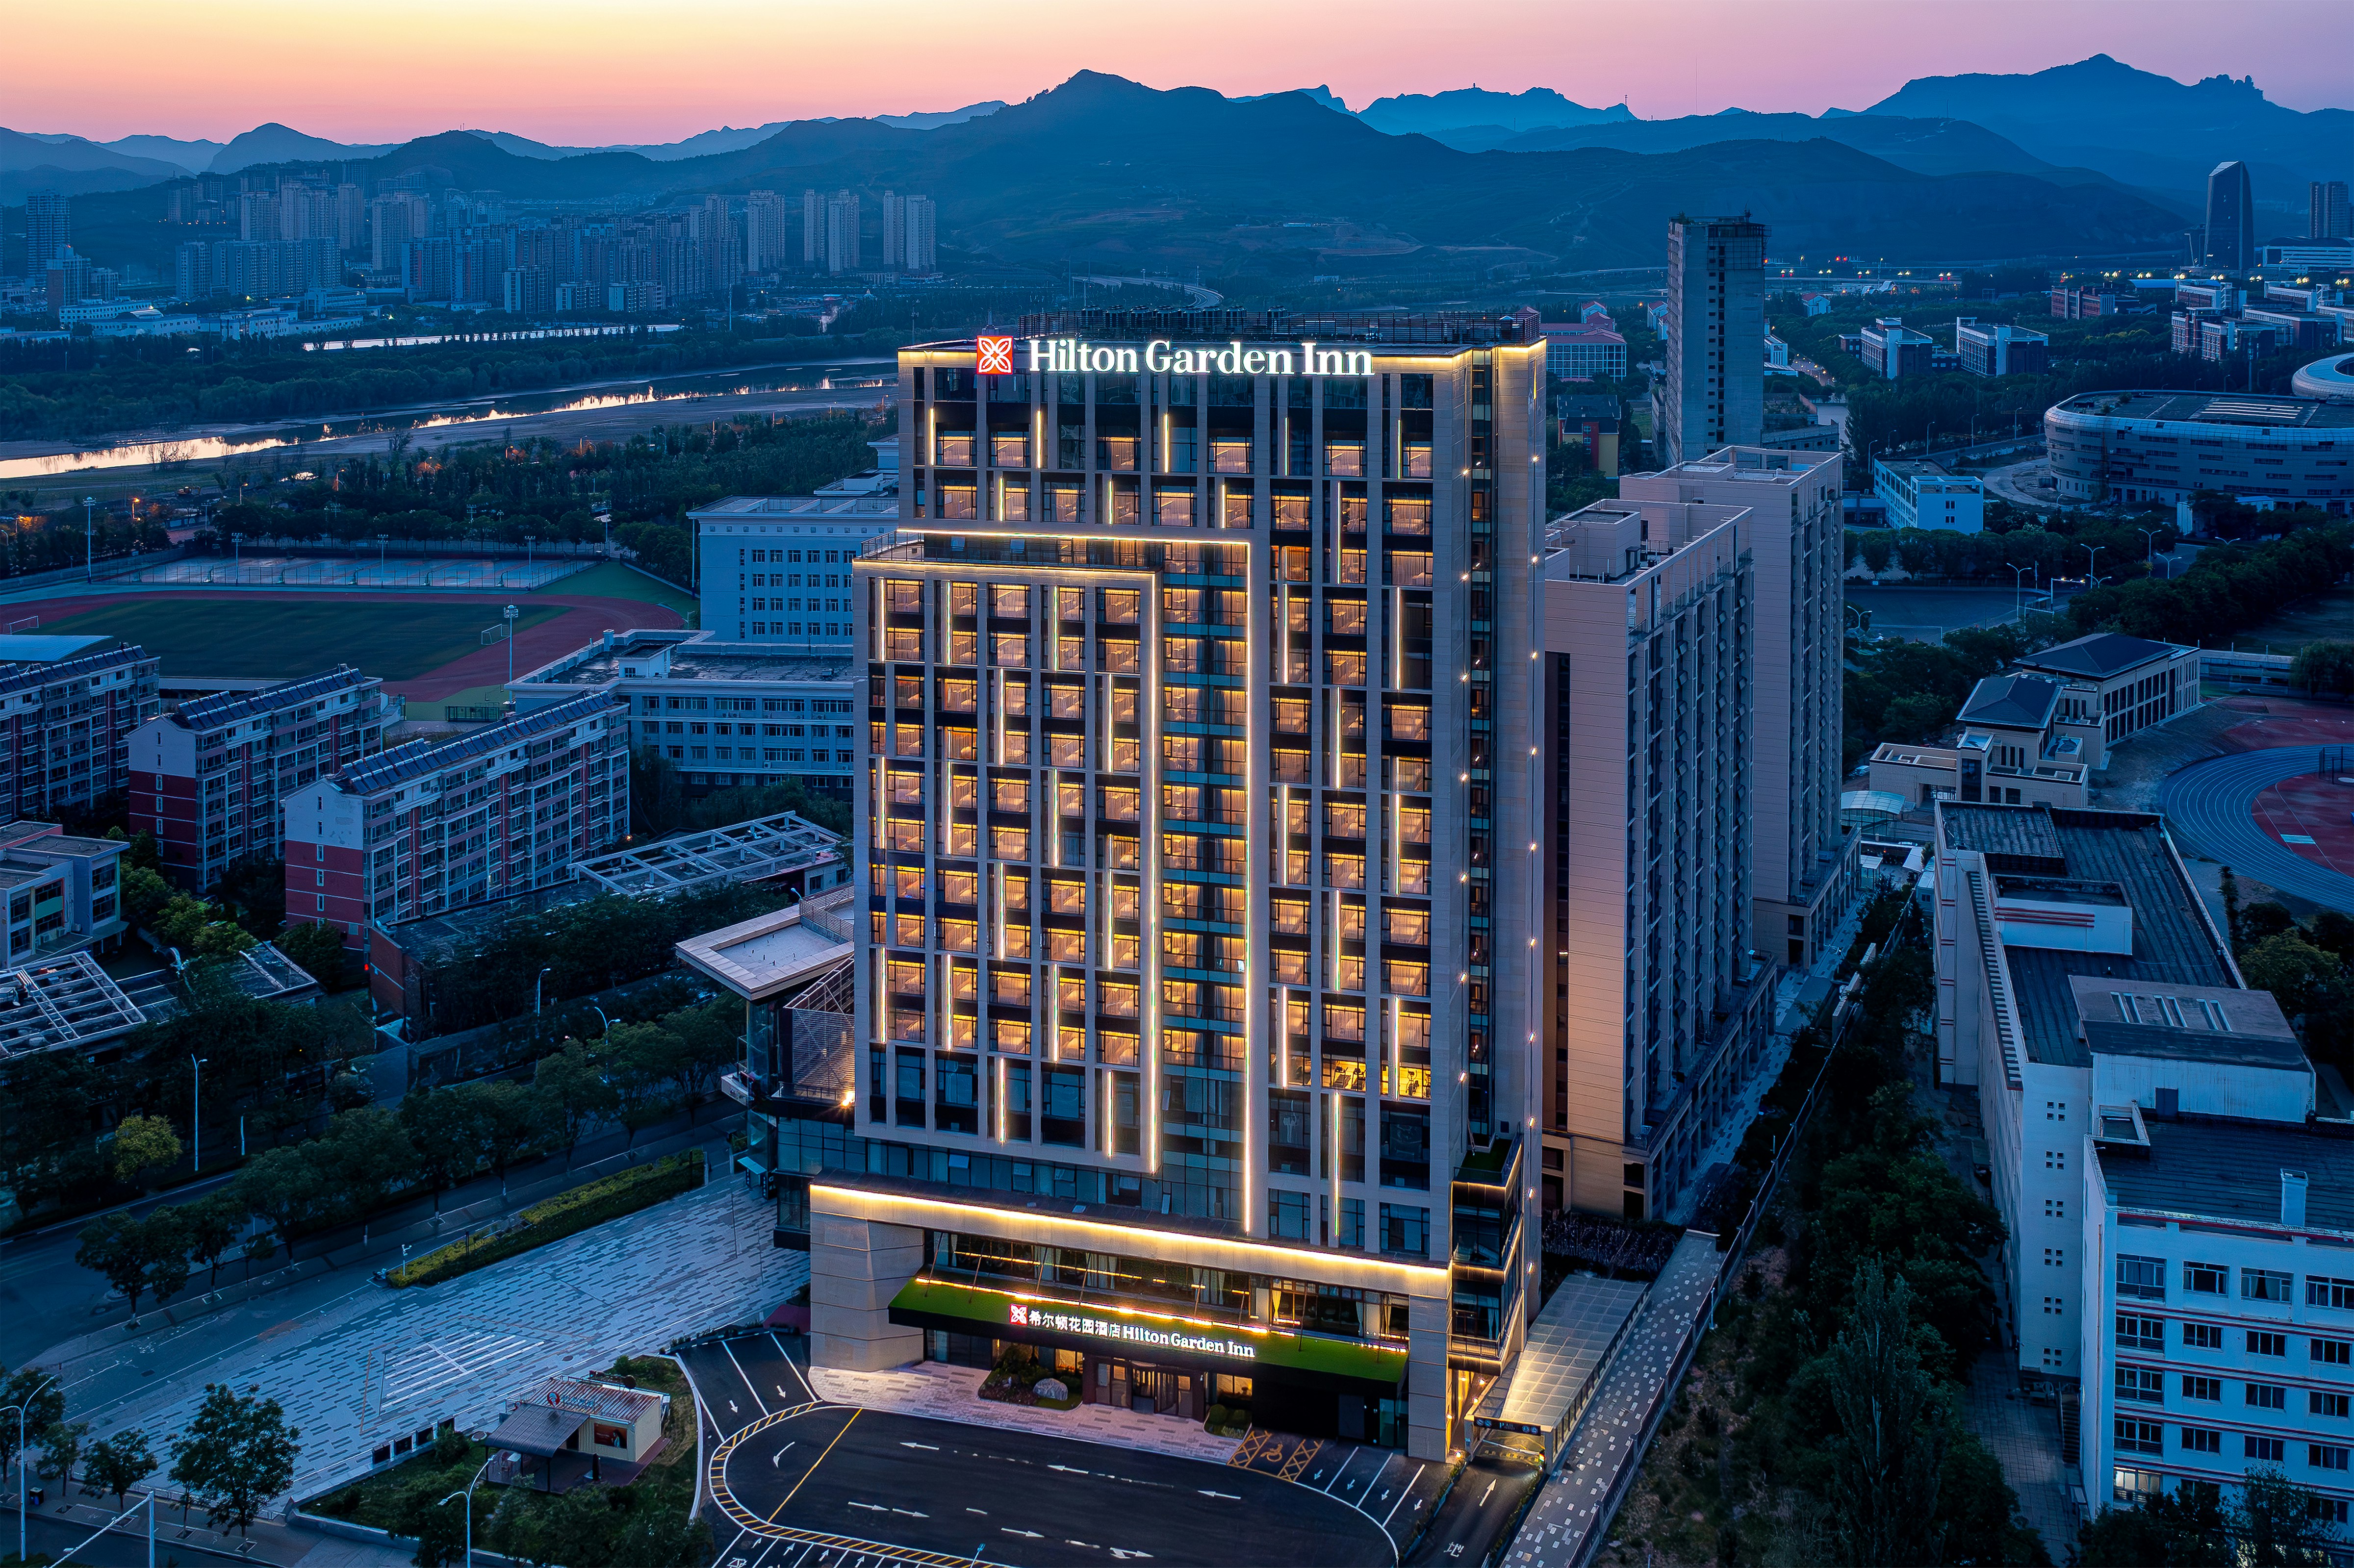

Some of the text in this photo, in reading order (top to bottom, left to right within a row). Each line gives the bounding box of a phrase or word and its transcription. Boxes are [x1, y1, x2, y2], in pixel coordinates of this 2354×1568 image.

[1029, 339, 1375, 376] Hilton Garden Inn
[1028, 1310, 1255, 1358] 希尔顿花园酒店 Hilton Garden Inn
[1443, 1542, 1464, 1557] 地
